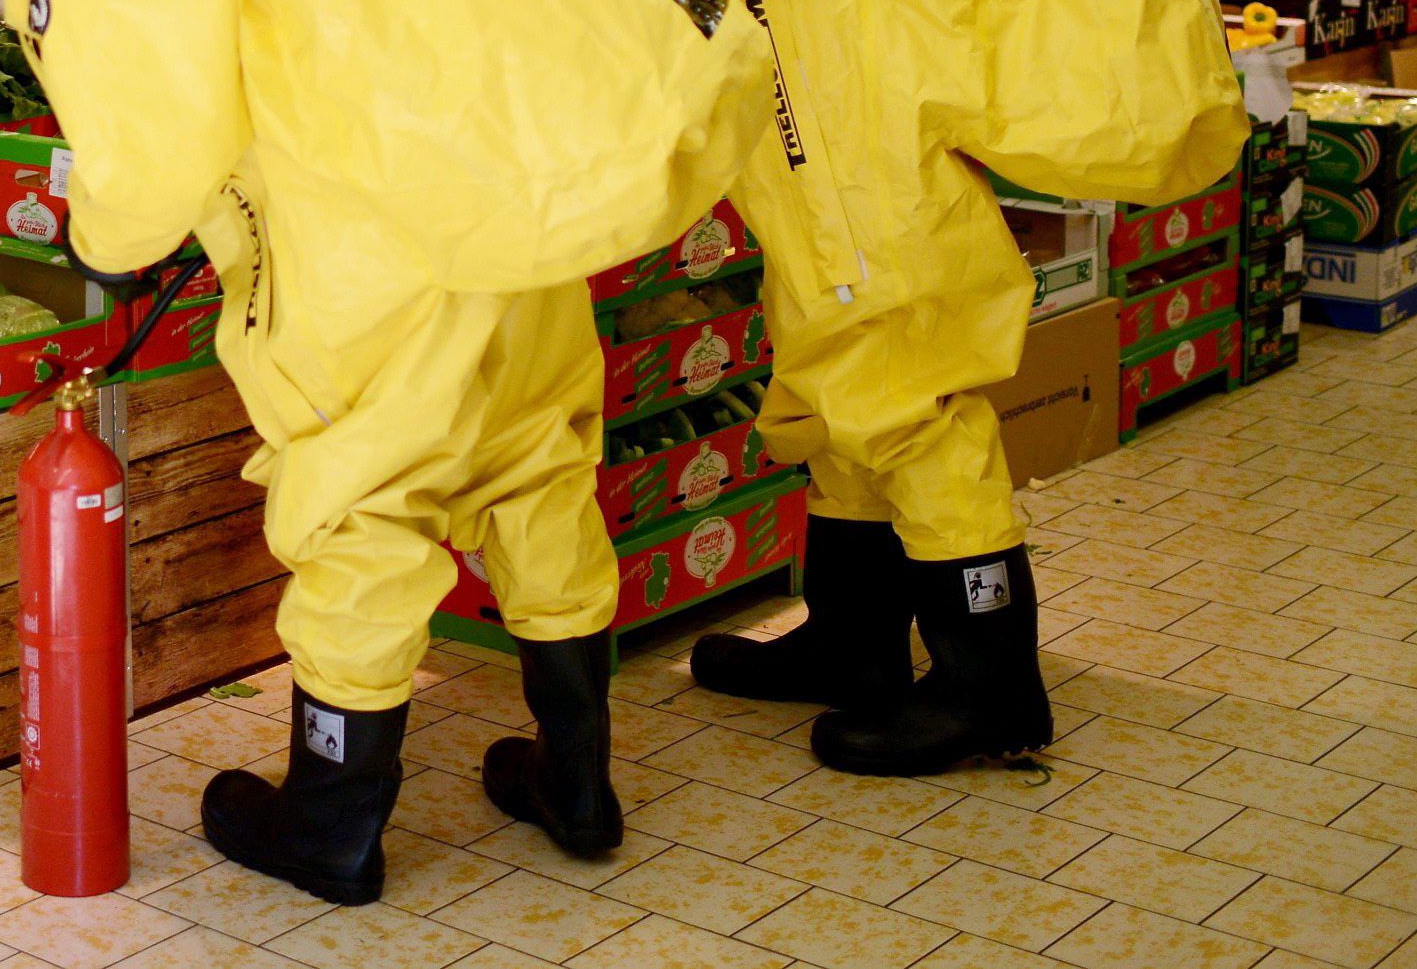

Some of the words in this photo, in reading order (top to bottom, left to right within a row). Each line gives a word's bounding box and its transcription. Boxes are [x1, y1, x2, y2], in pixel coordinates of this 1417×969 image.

[17, 219, 48, 237] Heimat
[689, 250, 721, 266] Heimat
[689, 364, 721, 383] Heimat
[687, 480, 719, 499] Heimat
[694, 527, 726, 552] Heimat
